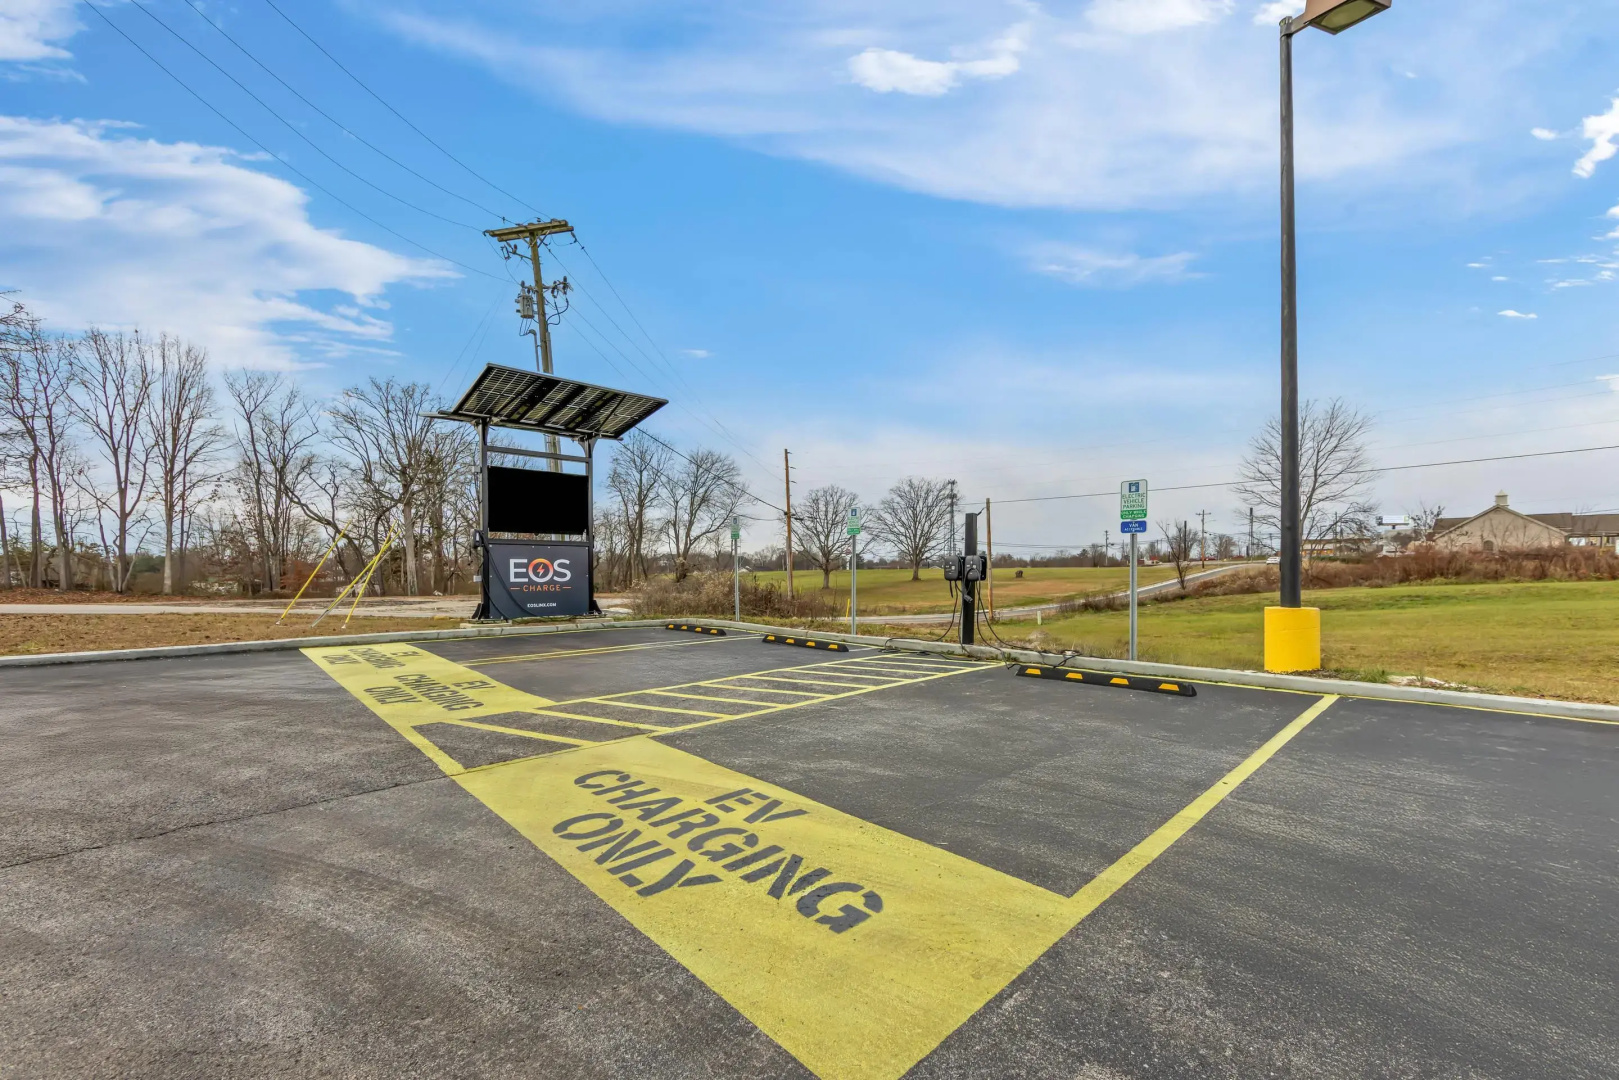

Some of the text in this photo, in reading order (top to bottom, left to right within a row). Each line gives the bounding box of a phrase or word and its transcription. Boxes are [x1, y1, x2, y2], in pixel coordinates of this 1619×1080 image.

[509, 558, 572, 583] EOS
[522, 584, 561, 592] CHARGE
[363, 686, 422, 705] ONLY
[393, 674, 484, 711] CHARGING
[452, 680, 497, 690] EV
[703, 788, 810, 824] EV
[552, 813, 724, 898] ONLY
[573, 770, 884, 934] CHARGING
